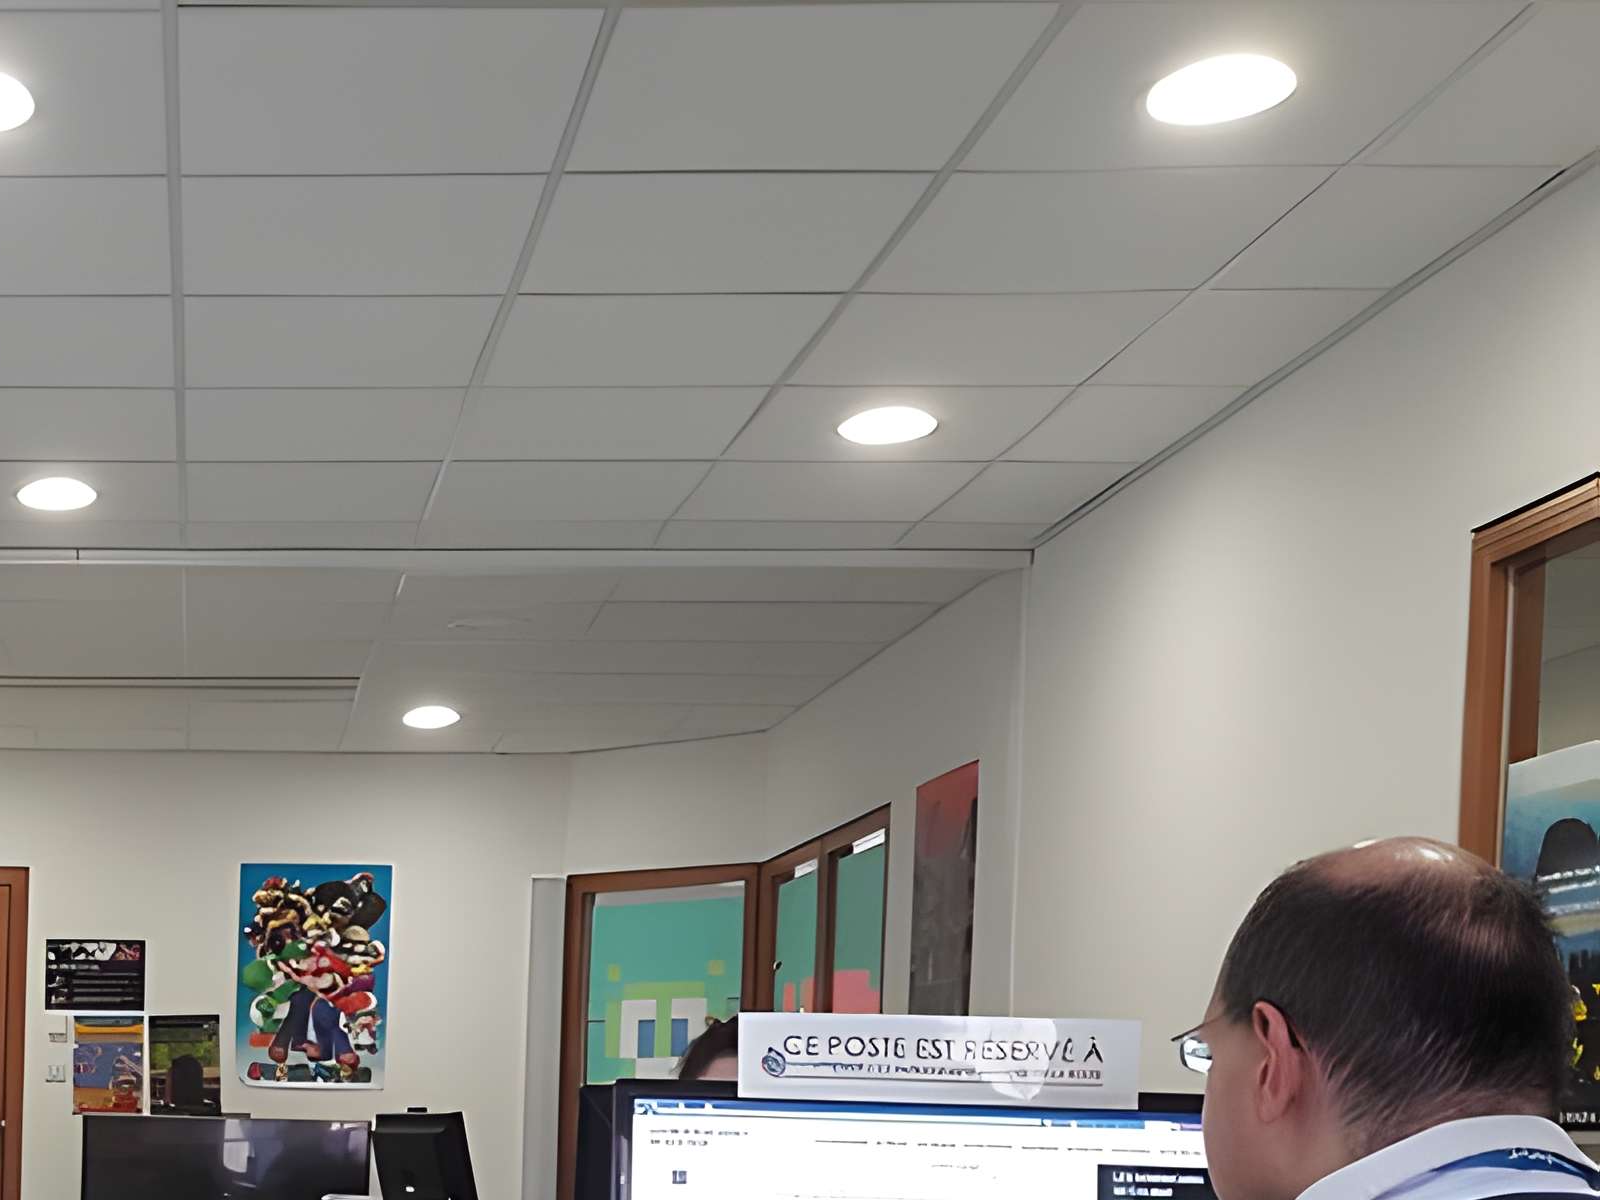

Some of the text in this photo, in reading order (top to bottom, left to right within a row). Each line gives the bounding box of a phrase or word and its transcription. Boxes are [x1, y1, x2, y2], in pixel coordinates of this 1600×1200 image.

[783, 1035, 819, 1056] CE
[828, 1036, 906, 1058] POSTE
[916, 1037, 956, 1060] EST
